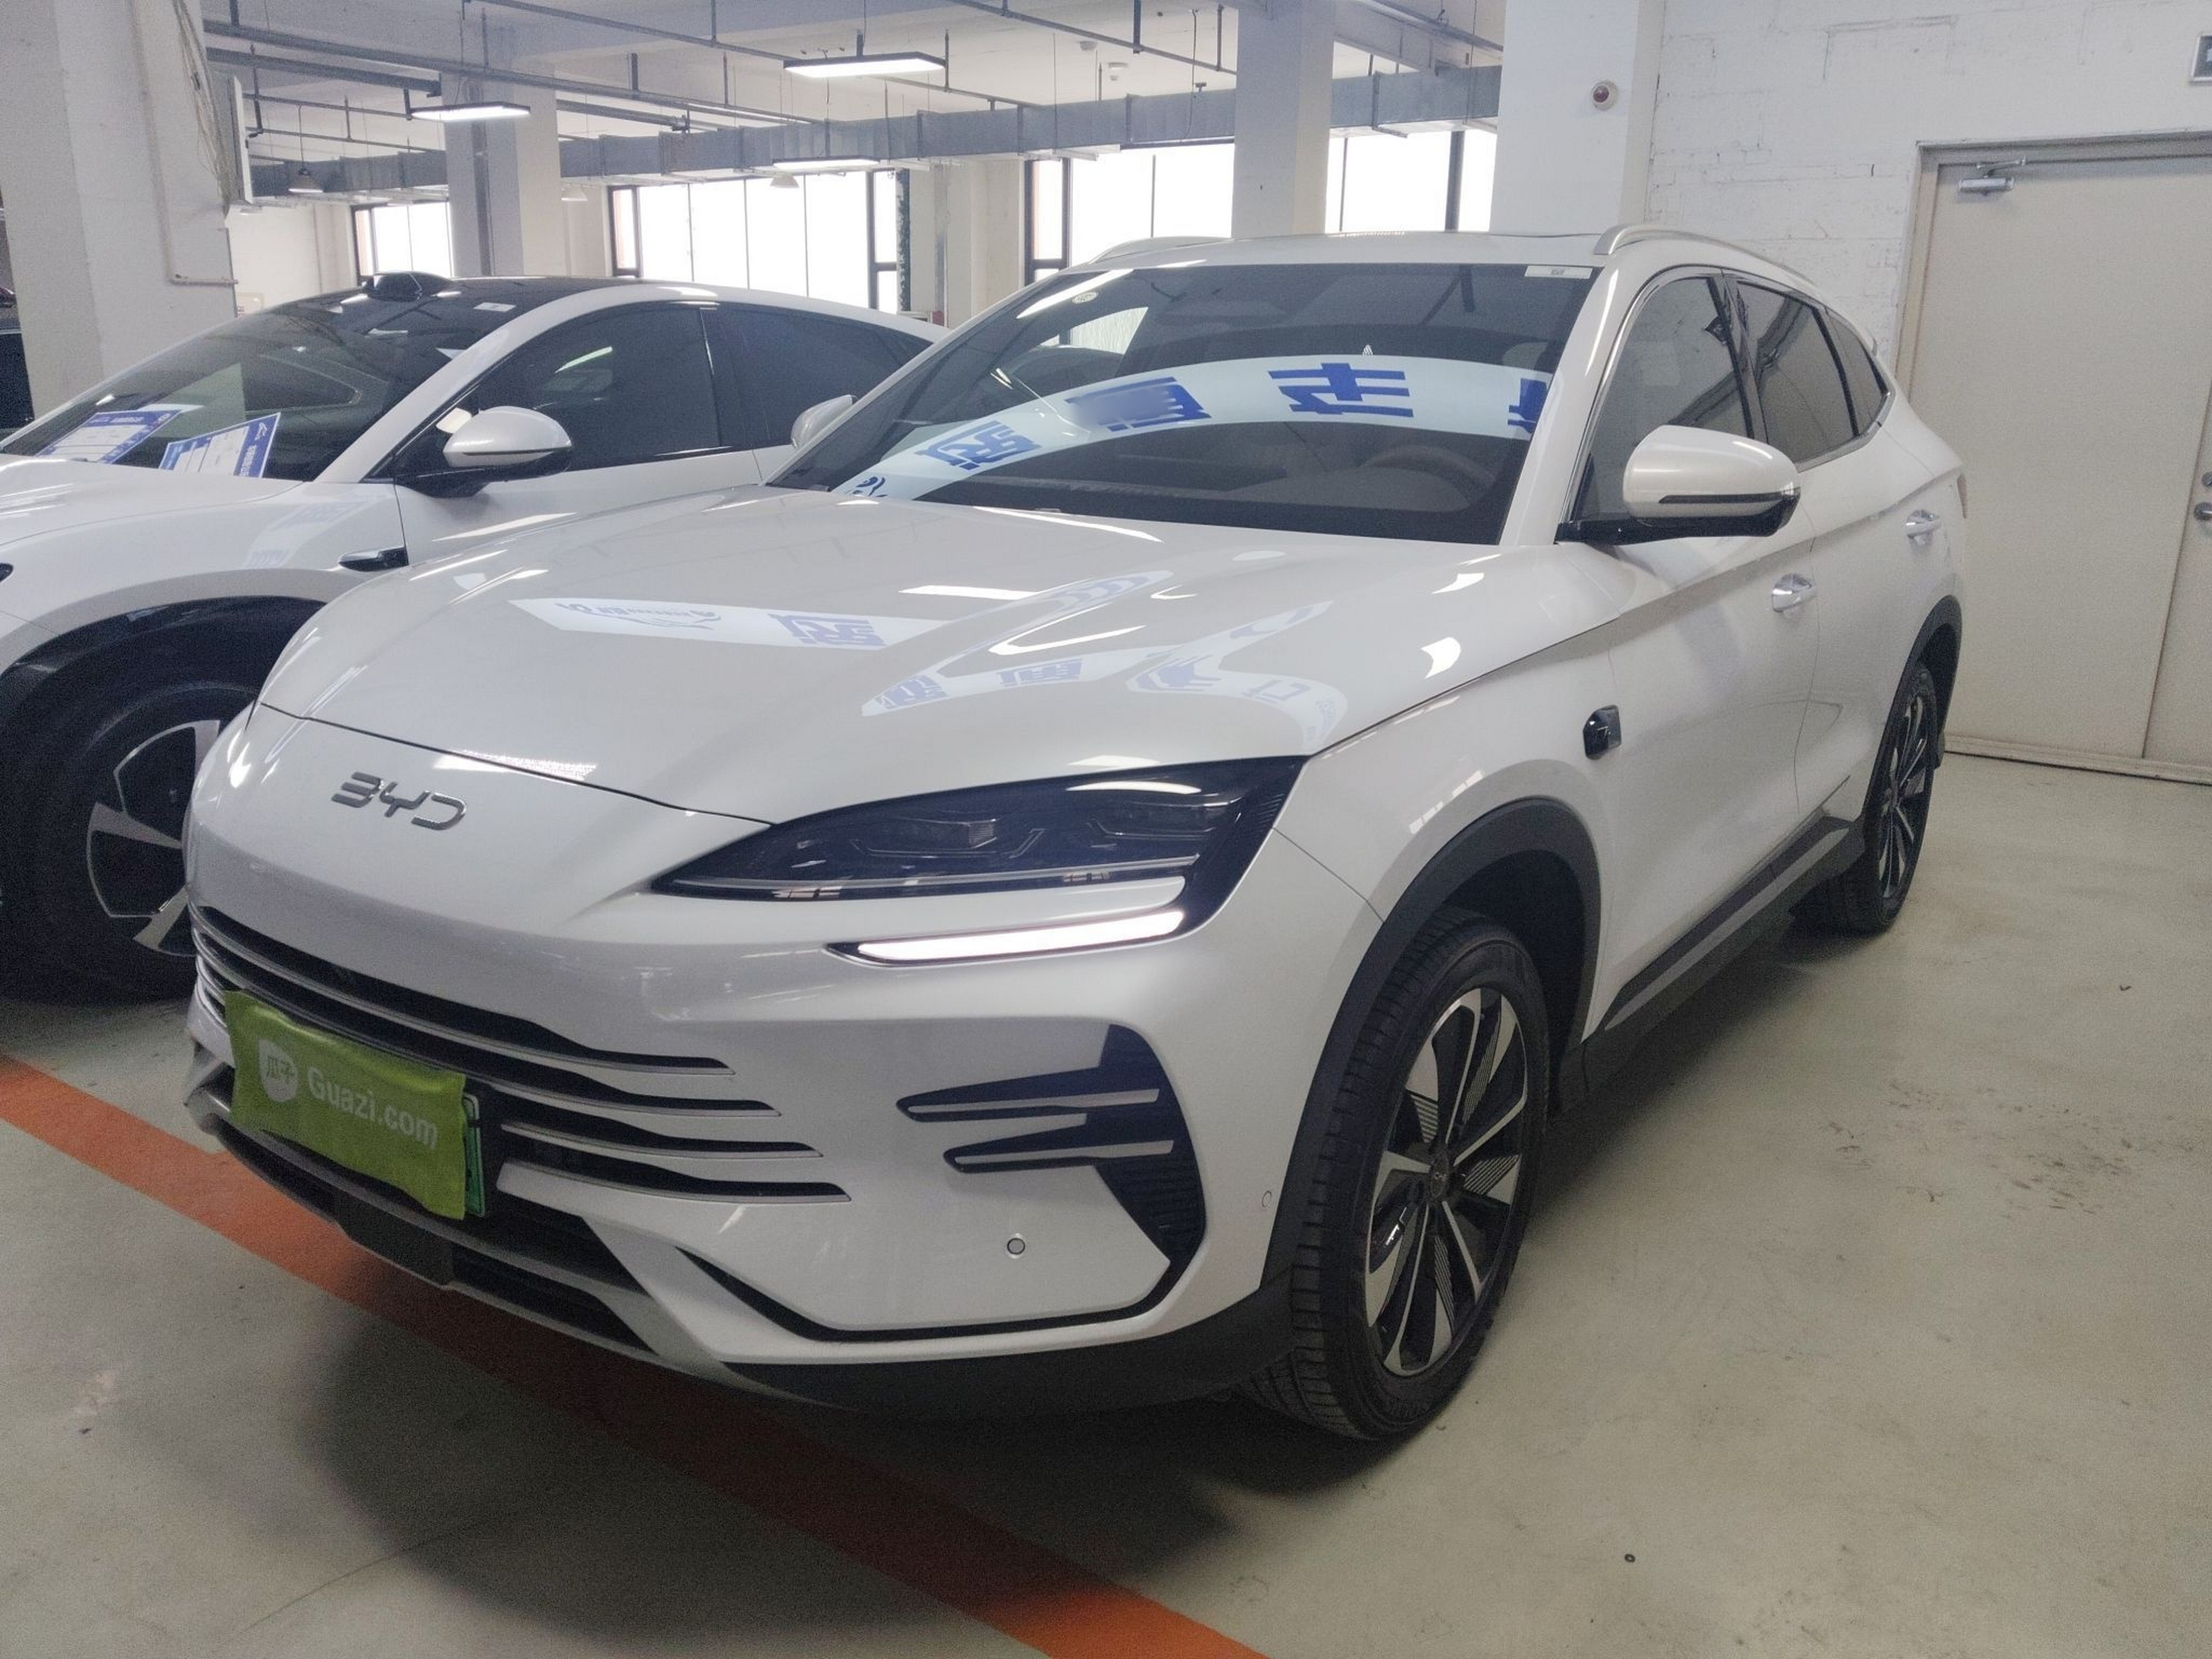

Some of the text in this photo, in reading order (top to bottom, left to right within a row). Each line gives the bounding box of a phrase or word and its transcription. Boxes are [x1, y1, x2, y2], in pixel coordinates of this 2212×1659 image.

[331, 771, 467, 831] BYD
[266, 1055, 296, 1085] 瓜子
[308, 1066, 437, 1150] Guazi.com
